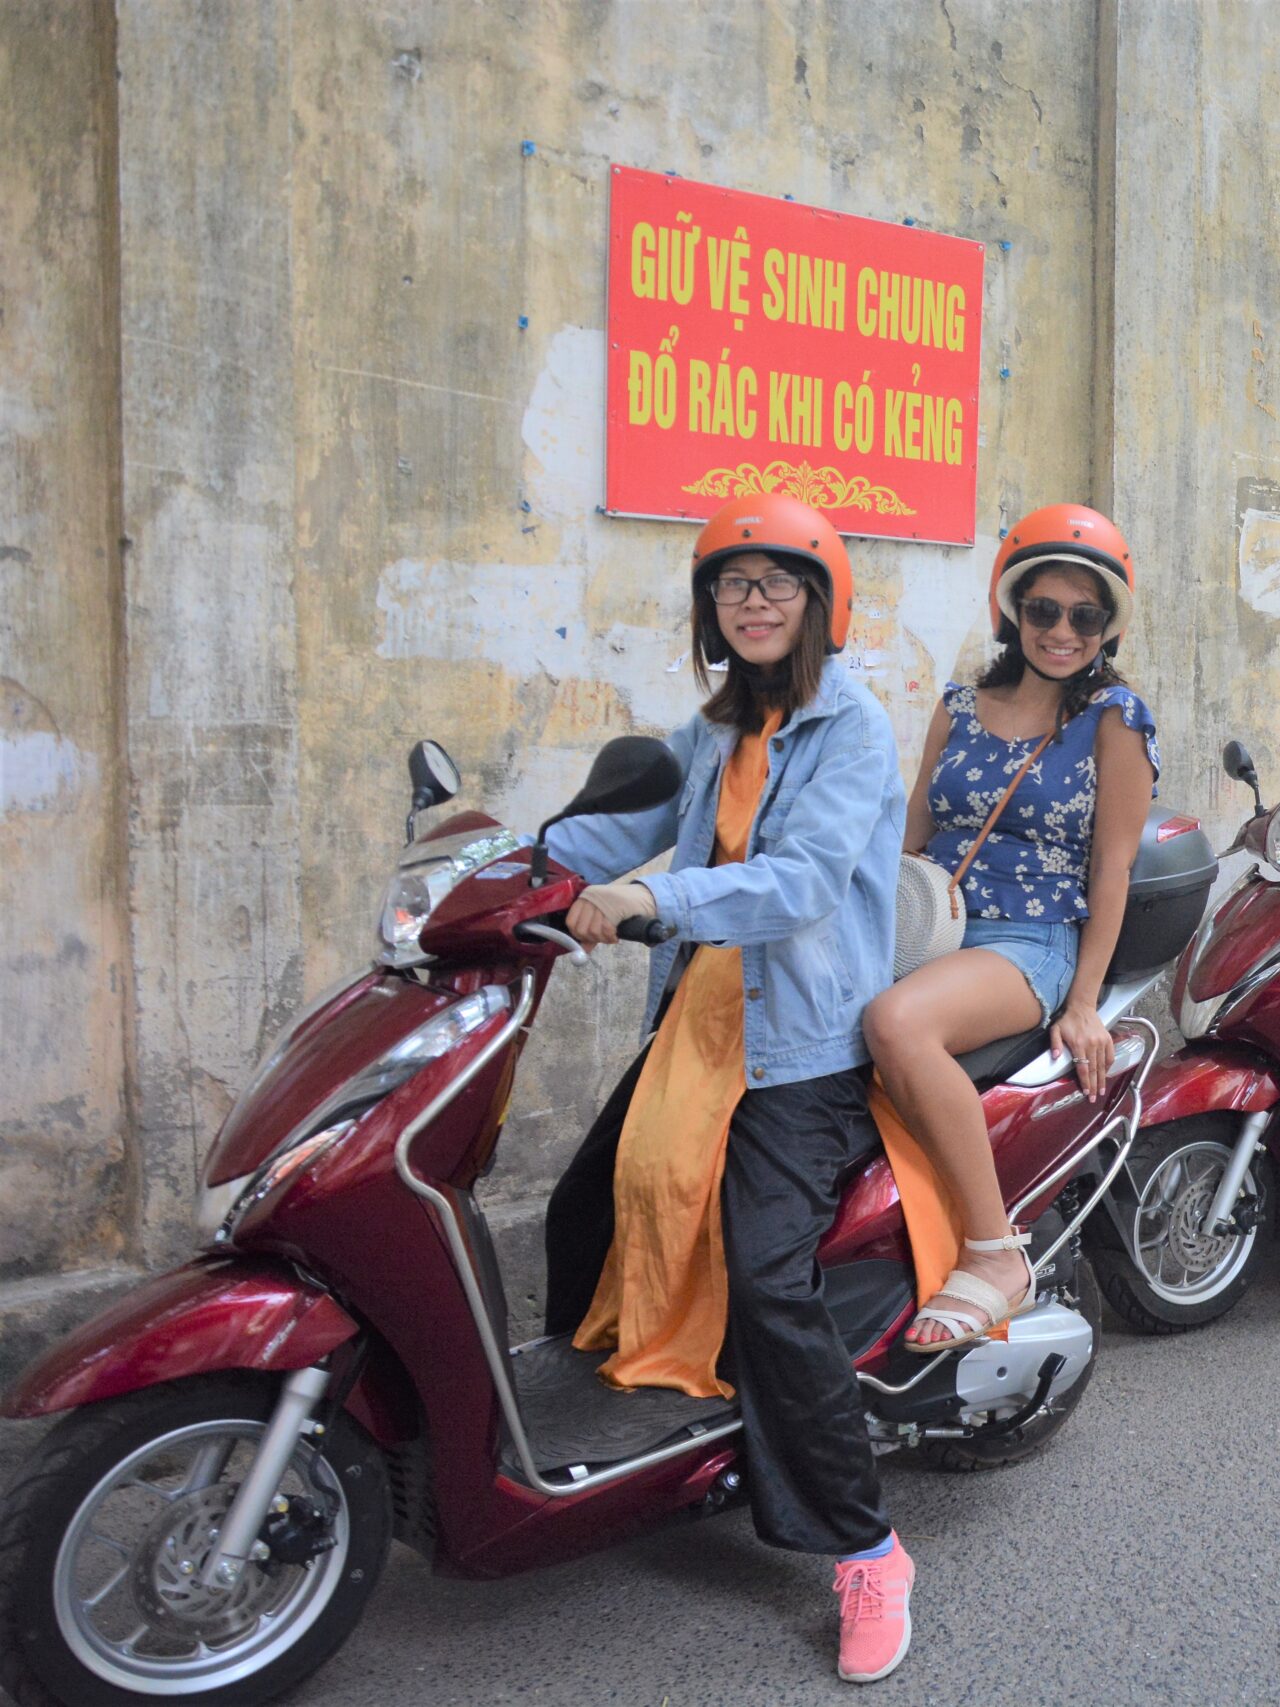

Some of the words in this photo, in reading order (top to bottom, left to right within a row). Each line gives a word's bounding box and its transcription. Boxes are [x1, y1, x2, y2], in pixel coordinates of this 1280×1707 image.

[631, 210, 702, 305] GIỮ
[707, 225, 751, 332] VỆ
[762, 247, 847, 332] SINH
[856, 266, 966, 353] CHUNG
[627, 325, 680, 429] ĐỔ
[688, 347, 758, 439] RÁC
[768, 371, 823, 448] KHI
[833, 370, 875, 454] CÓ
[884, 362, 964, 465] KẺNG
